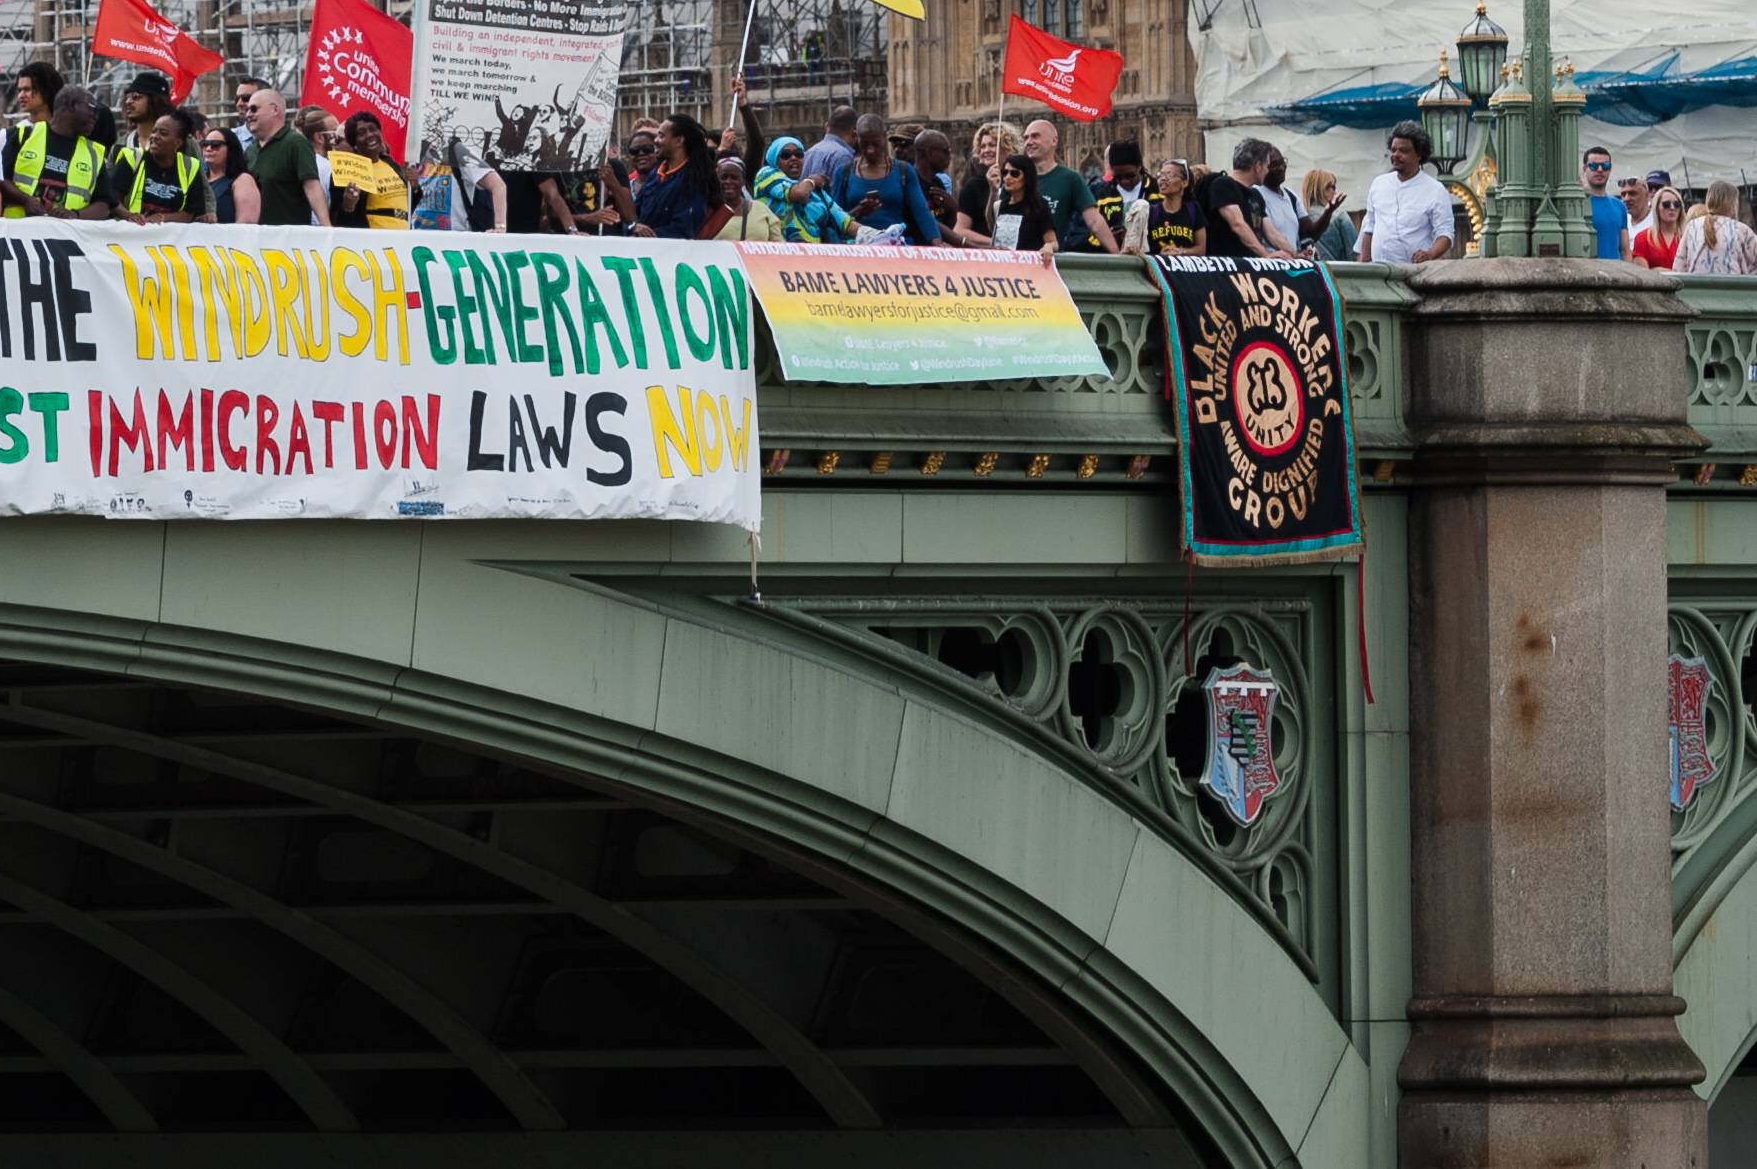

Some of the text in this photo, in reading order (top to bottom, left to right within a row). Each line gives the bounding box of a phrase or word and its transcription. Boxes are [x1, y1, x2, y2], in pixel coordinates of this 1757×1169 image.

[435, 4, 456, 19] Shut
[458, 7, 483, 22] Down
[485, 9, 529, 27] Detention
[529, 14, 563, 30] Centres
[569, 20, 589, 34] Stop
[533, 0, 548, 12] No
[550, 2, 578, 15] More
[433, 26, 474, 41] Building
[478, 31, 490, 39] an
[432, 41, 452, 52] civil
[456, 43, 465, 52] &
[469, 43, 518, 58] immigrant
[522, 49, 550, 62] rights
[432, 54, 447, 63] We
[450, 56, 481, 67] march
[430, 78, 518, 94] we keep marching
[448, 68, 479, 78] march
[482, 70, 527, 82] tomorrow
[530, 74, 537, 83] &
[347, 80, 406, 129] membership
[430, 89, 469, 100] TILL WE
[1161, 255, 1238, 272] LAMBETH
[779, 271, 1041, 300] BAME LAWYERS 4 JUSTICE
[806, 300, 1039, 323] bamelawyersforjustice@gmail.com
[1191, 291, 1228, 424] BLACK
[1213, 318, 1238, 402] UNITED
[1240, 304, 1272, 333] AND
[88, 387, 442, 478] IMMIGRATION
[467, 391, 632, 488] LAWS
[645, 385, 752, 479] NOW
[1245, 411, 1296, 448] UNITY
[1220, 417, 1324, 494] AWARE DIGNIFIED
